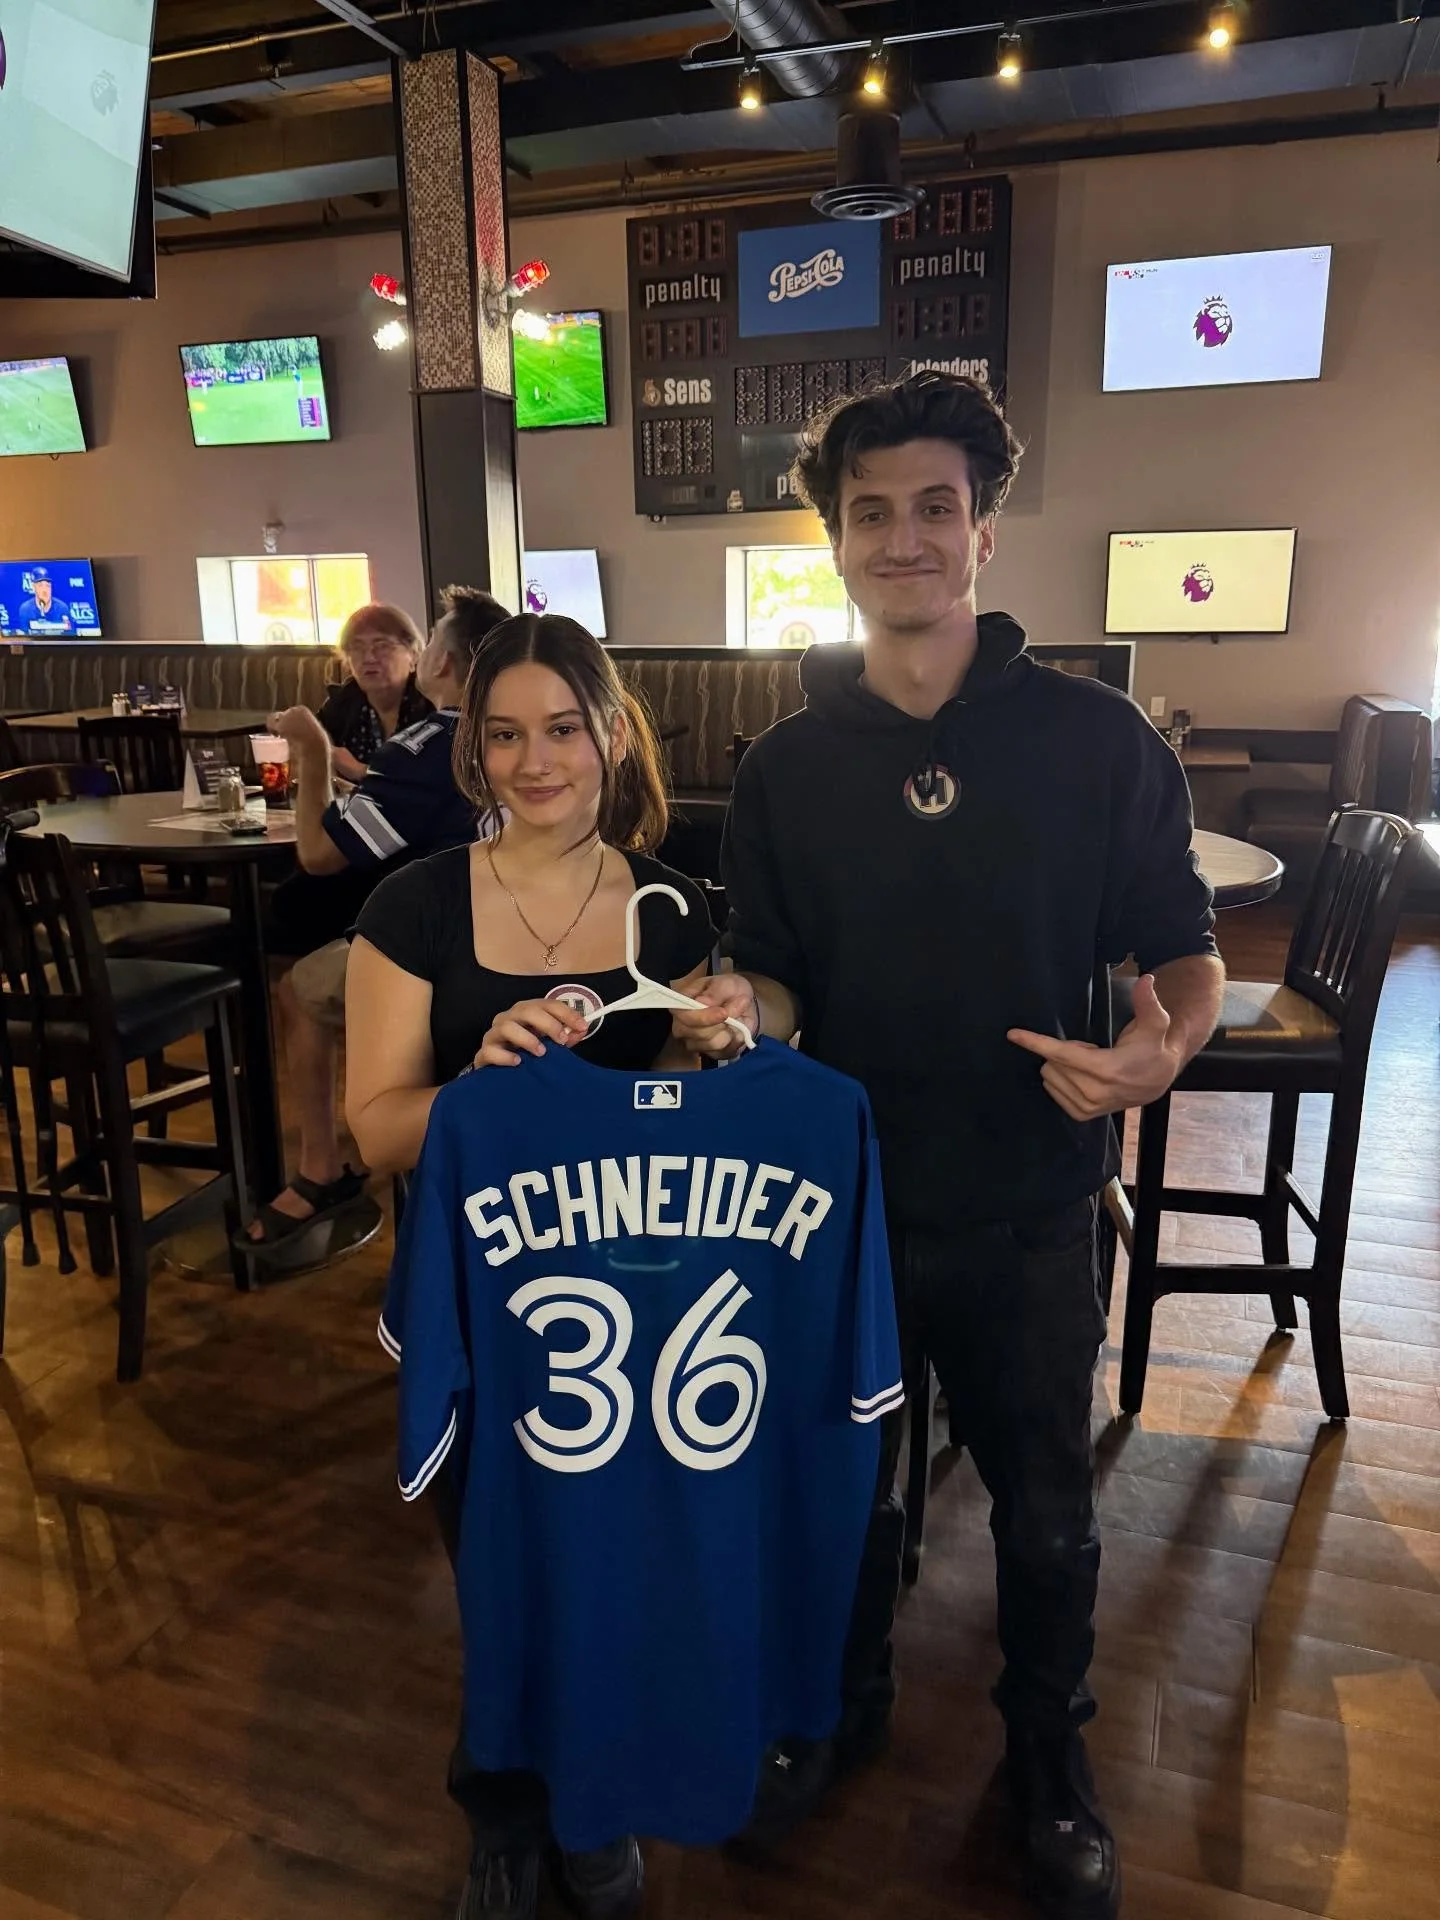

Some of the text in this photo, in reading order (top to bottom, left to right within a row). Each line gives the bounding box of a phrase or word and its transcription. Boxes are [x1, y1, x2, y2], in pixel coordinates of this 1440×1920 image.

[900, 246, 985, 286] penalty
[645, 273, 721, 310] penalty
[664, 377, 712, 406] Sens
[464, 1155, 834, 1267] SCHNEIDER
[505, 1268, 768, 1474] 36
